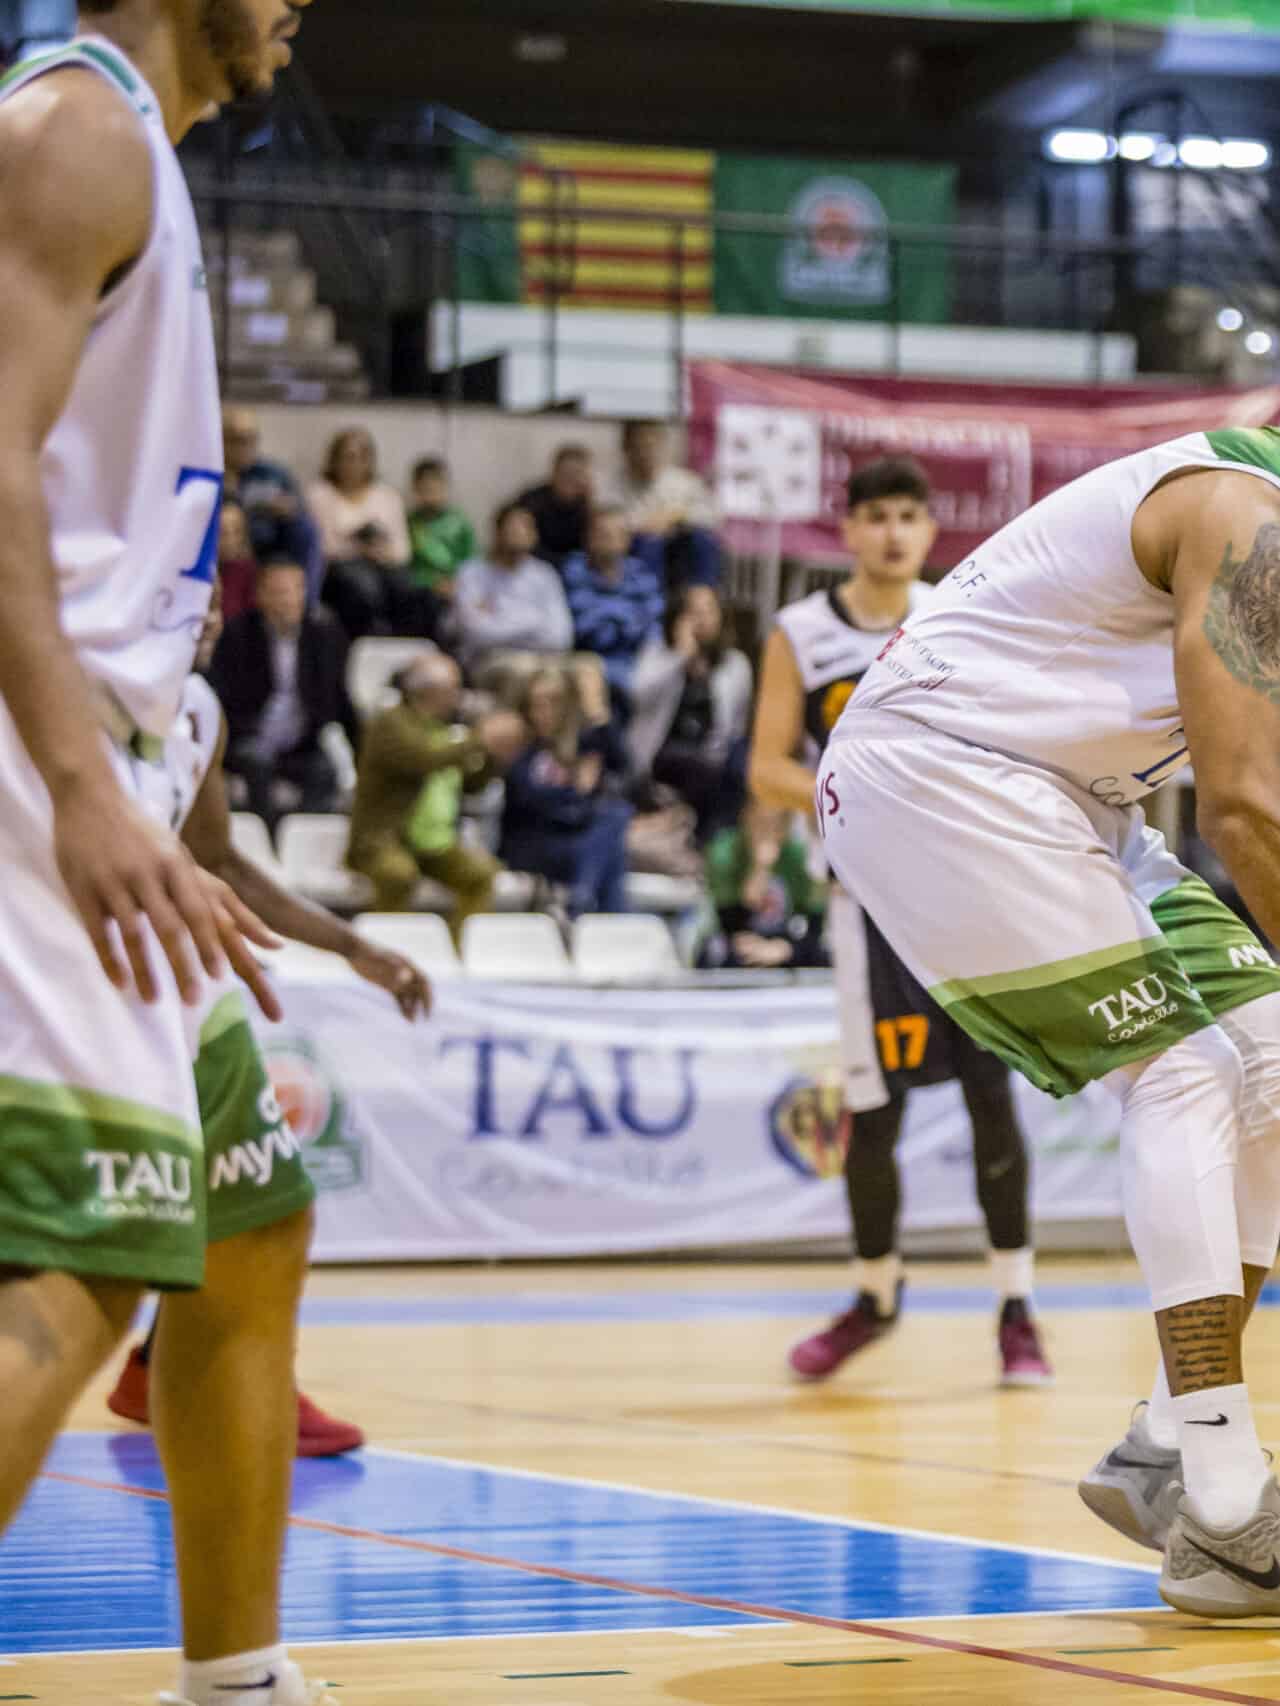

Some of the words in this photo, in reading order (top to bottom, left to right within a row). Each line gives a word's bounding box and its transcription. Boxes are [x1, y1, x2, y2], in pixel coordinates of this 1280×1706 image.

[1087, 972, 1168, 1031] TAU
[876, 1014, 929, 1072] 17
[438, 1032, 705, 1143] TAU
[82, 1148, 193, 1200] TAU
